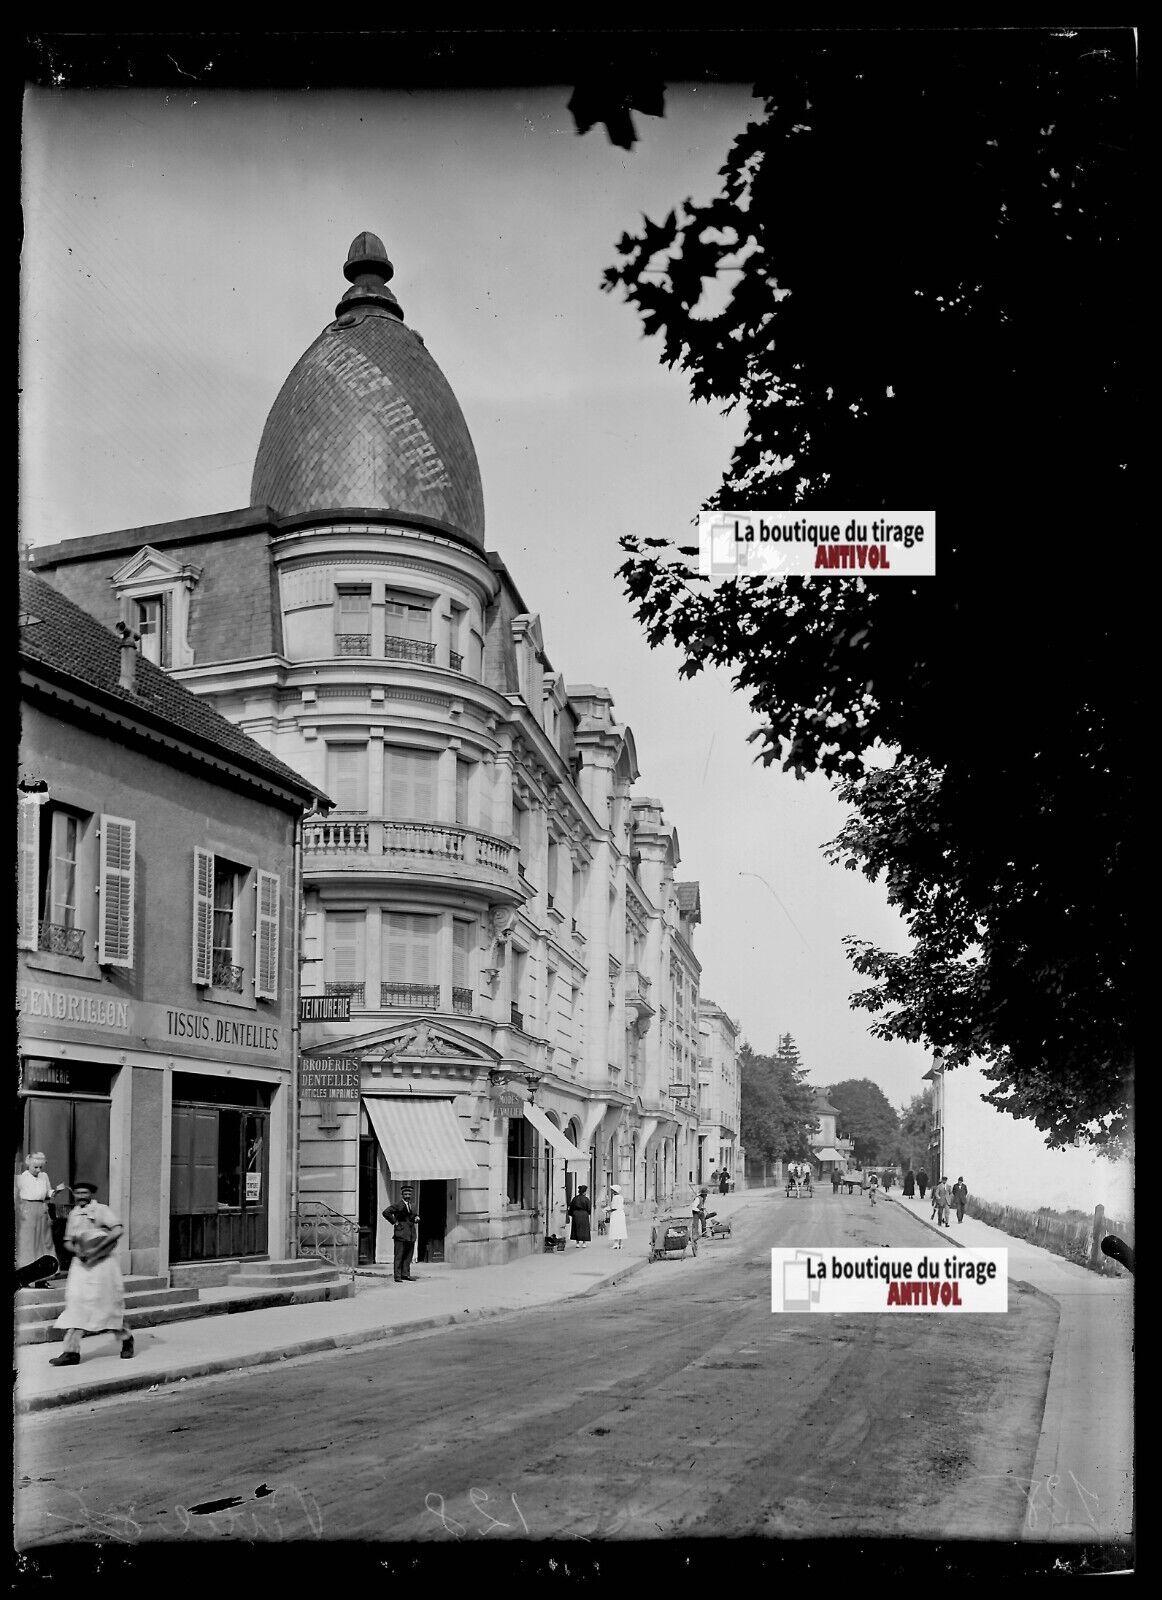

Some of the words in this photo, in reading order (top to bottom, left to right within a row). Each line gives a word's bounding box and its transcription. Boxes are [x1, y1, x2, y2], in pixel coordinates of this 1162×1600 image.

[301, 998, 350, 1019] TEINTURERIE
[216, 1019, 279, 1051] DENTELLES
[302, 1059, 359, 1071] BRODERIES
[302, 1074, 359, 1086] DENTELLES
[301, 1088, 327, 1098] ARTICLES
